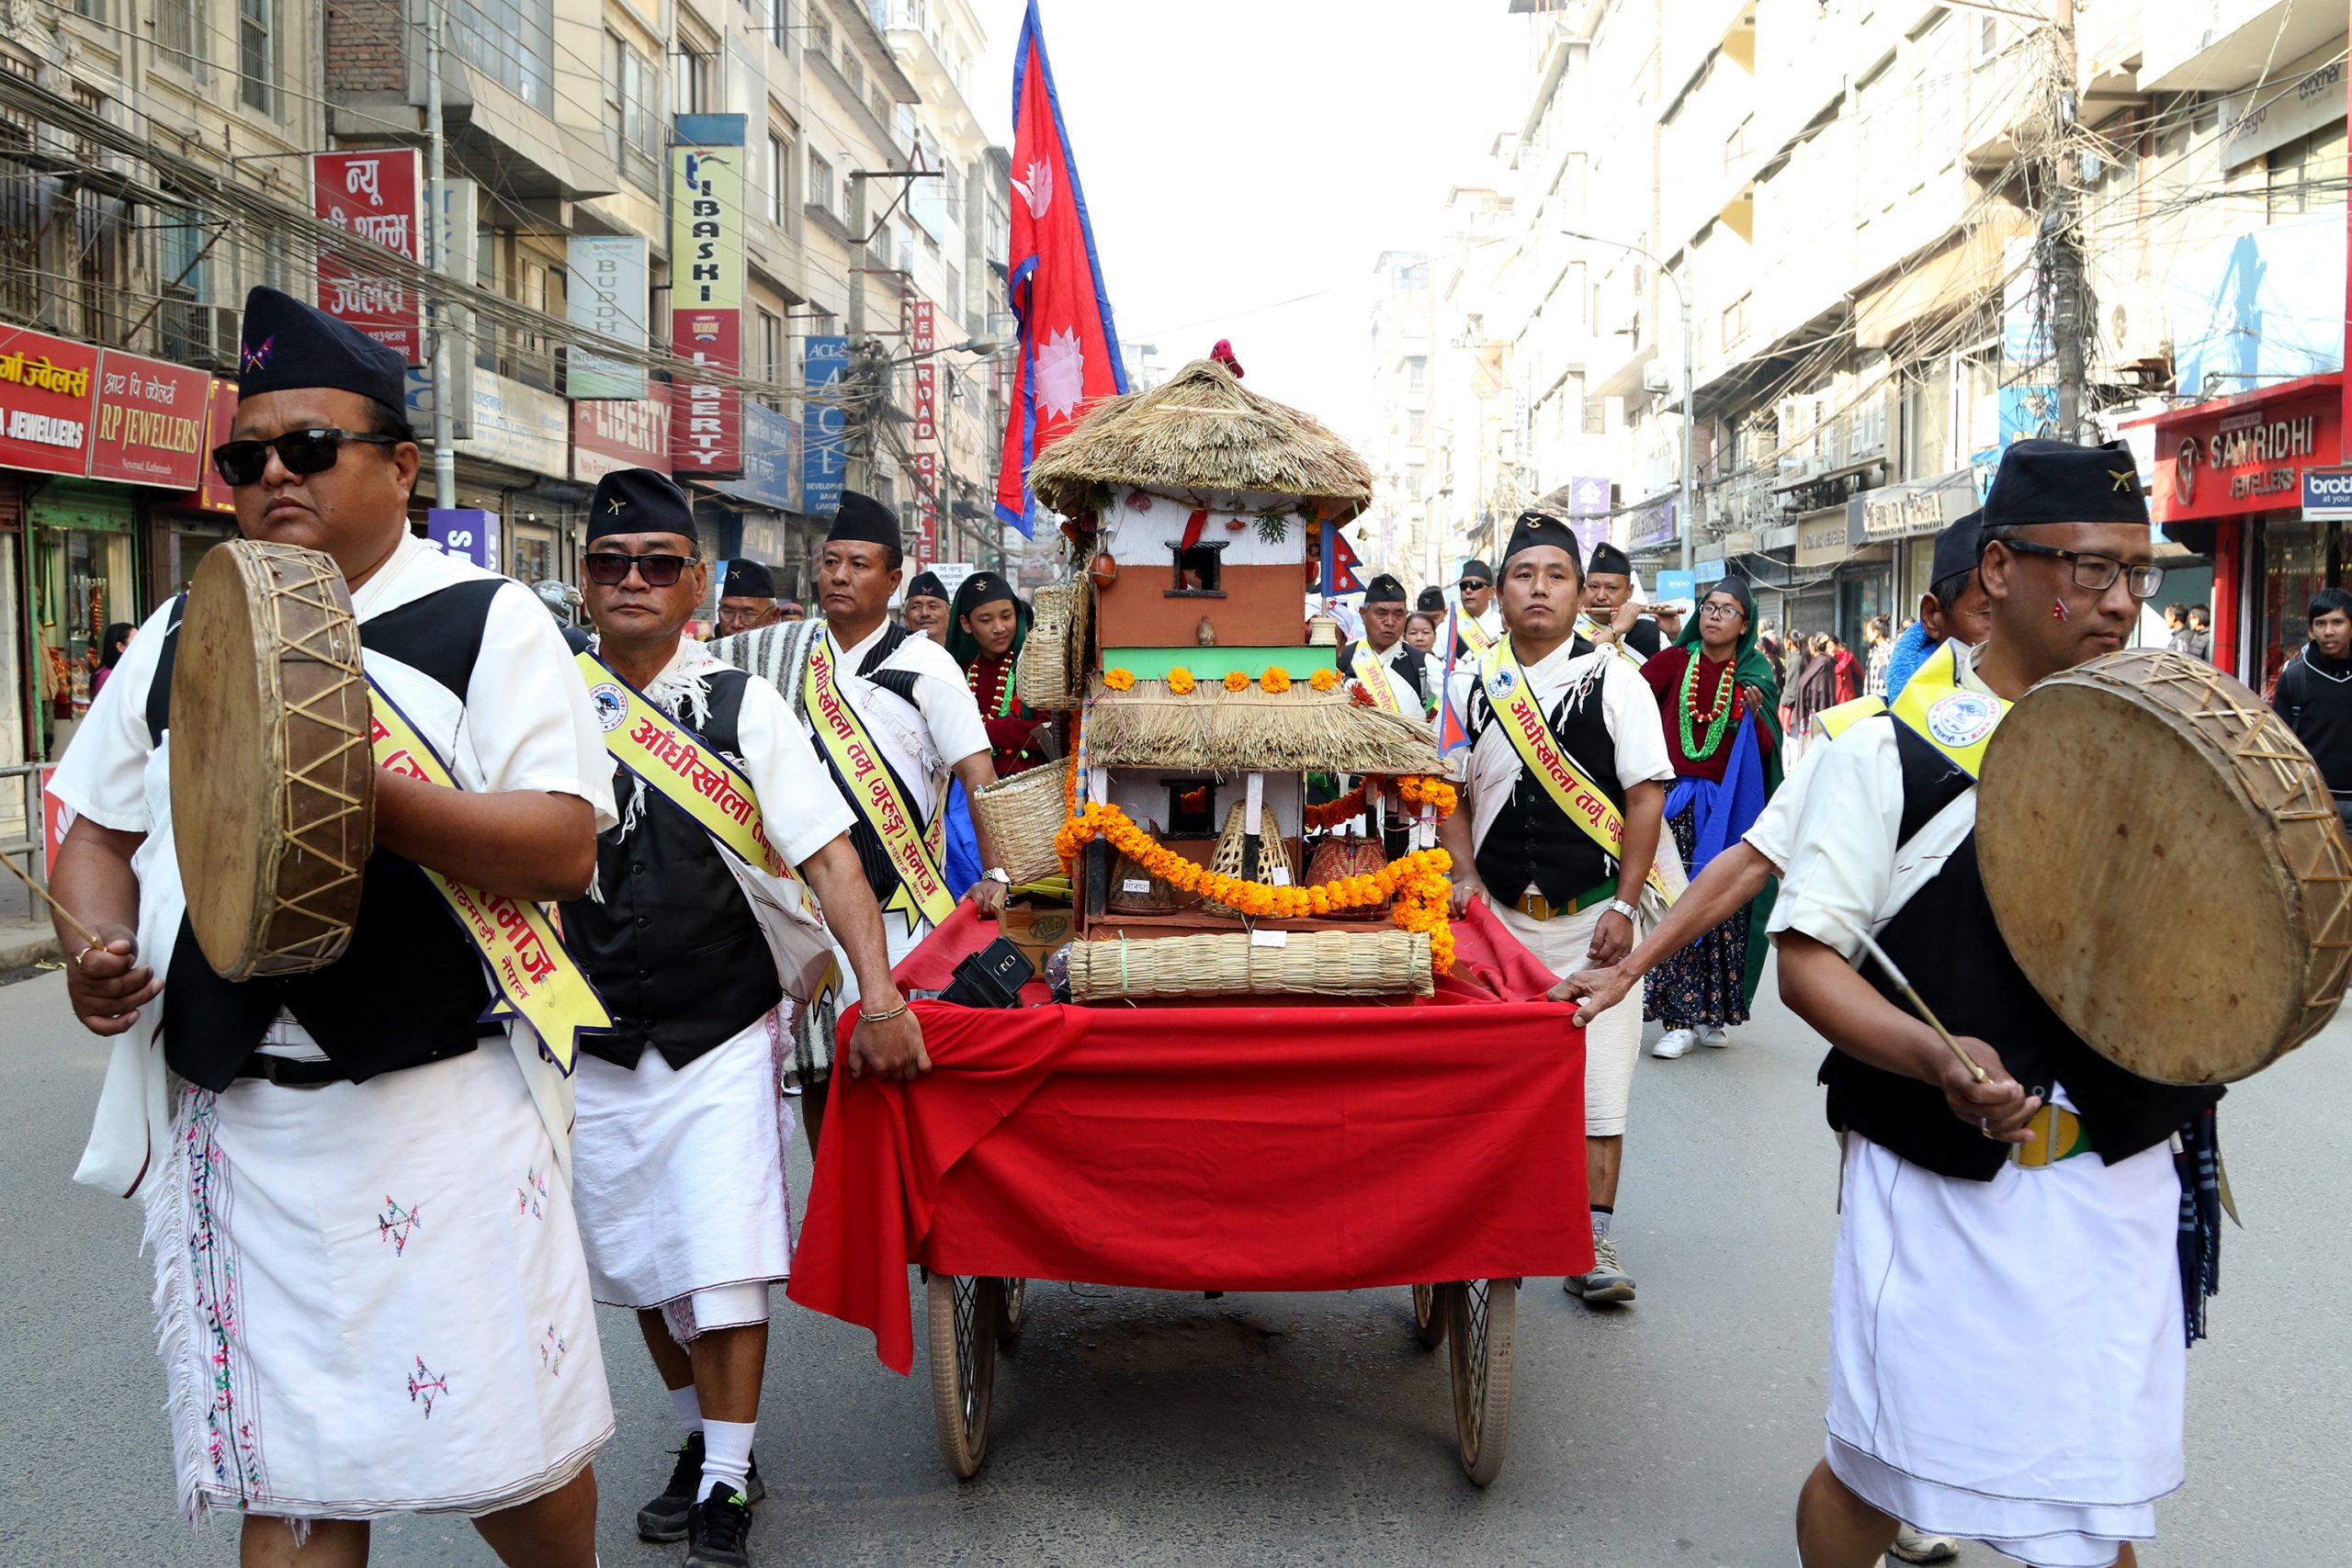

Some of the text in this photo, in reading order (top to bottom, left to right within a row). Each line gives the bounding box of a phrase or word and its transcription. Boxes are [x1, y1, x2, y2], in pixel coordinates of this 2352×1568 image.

[345, 160, 383, 206] न्यू
[917, 304, 933, 350] NEW
[808, 344, 838, 357] ACE
[918, 368, 933, 437] ROAD
[7, 410, 85, 449] JEWELLERS
[99, 403, 198, 454] RP JEWELLERS
[597, 400, 672, 457] LIBERTY
[2211, 415, 2313, 469] SAMRIDHI
[2230, 467, 2295, 499] JEWELLERS
[2323, 495, 2350, 505] at your
[629, 716, 754, 826] आँधीखोला
[846, 740, 876, 783] तमू
[902, 839, 939, 897] समाज
[1574, 788, 1607, 826] तमू
[502, 955, 530, 999] नेपाल
